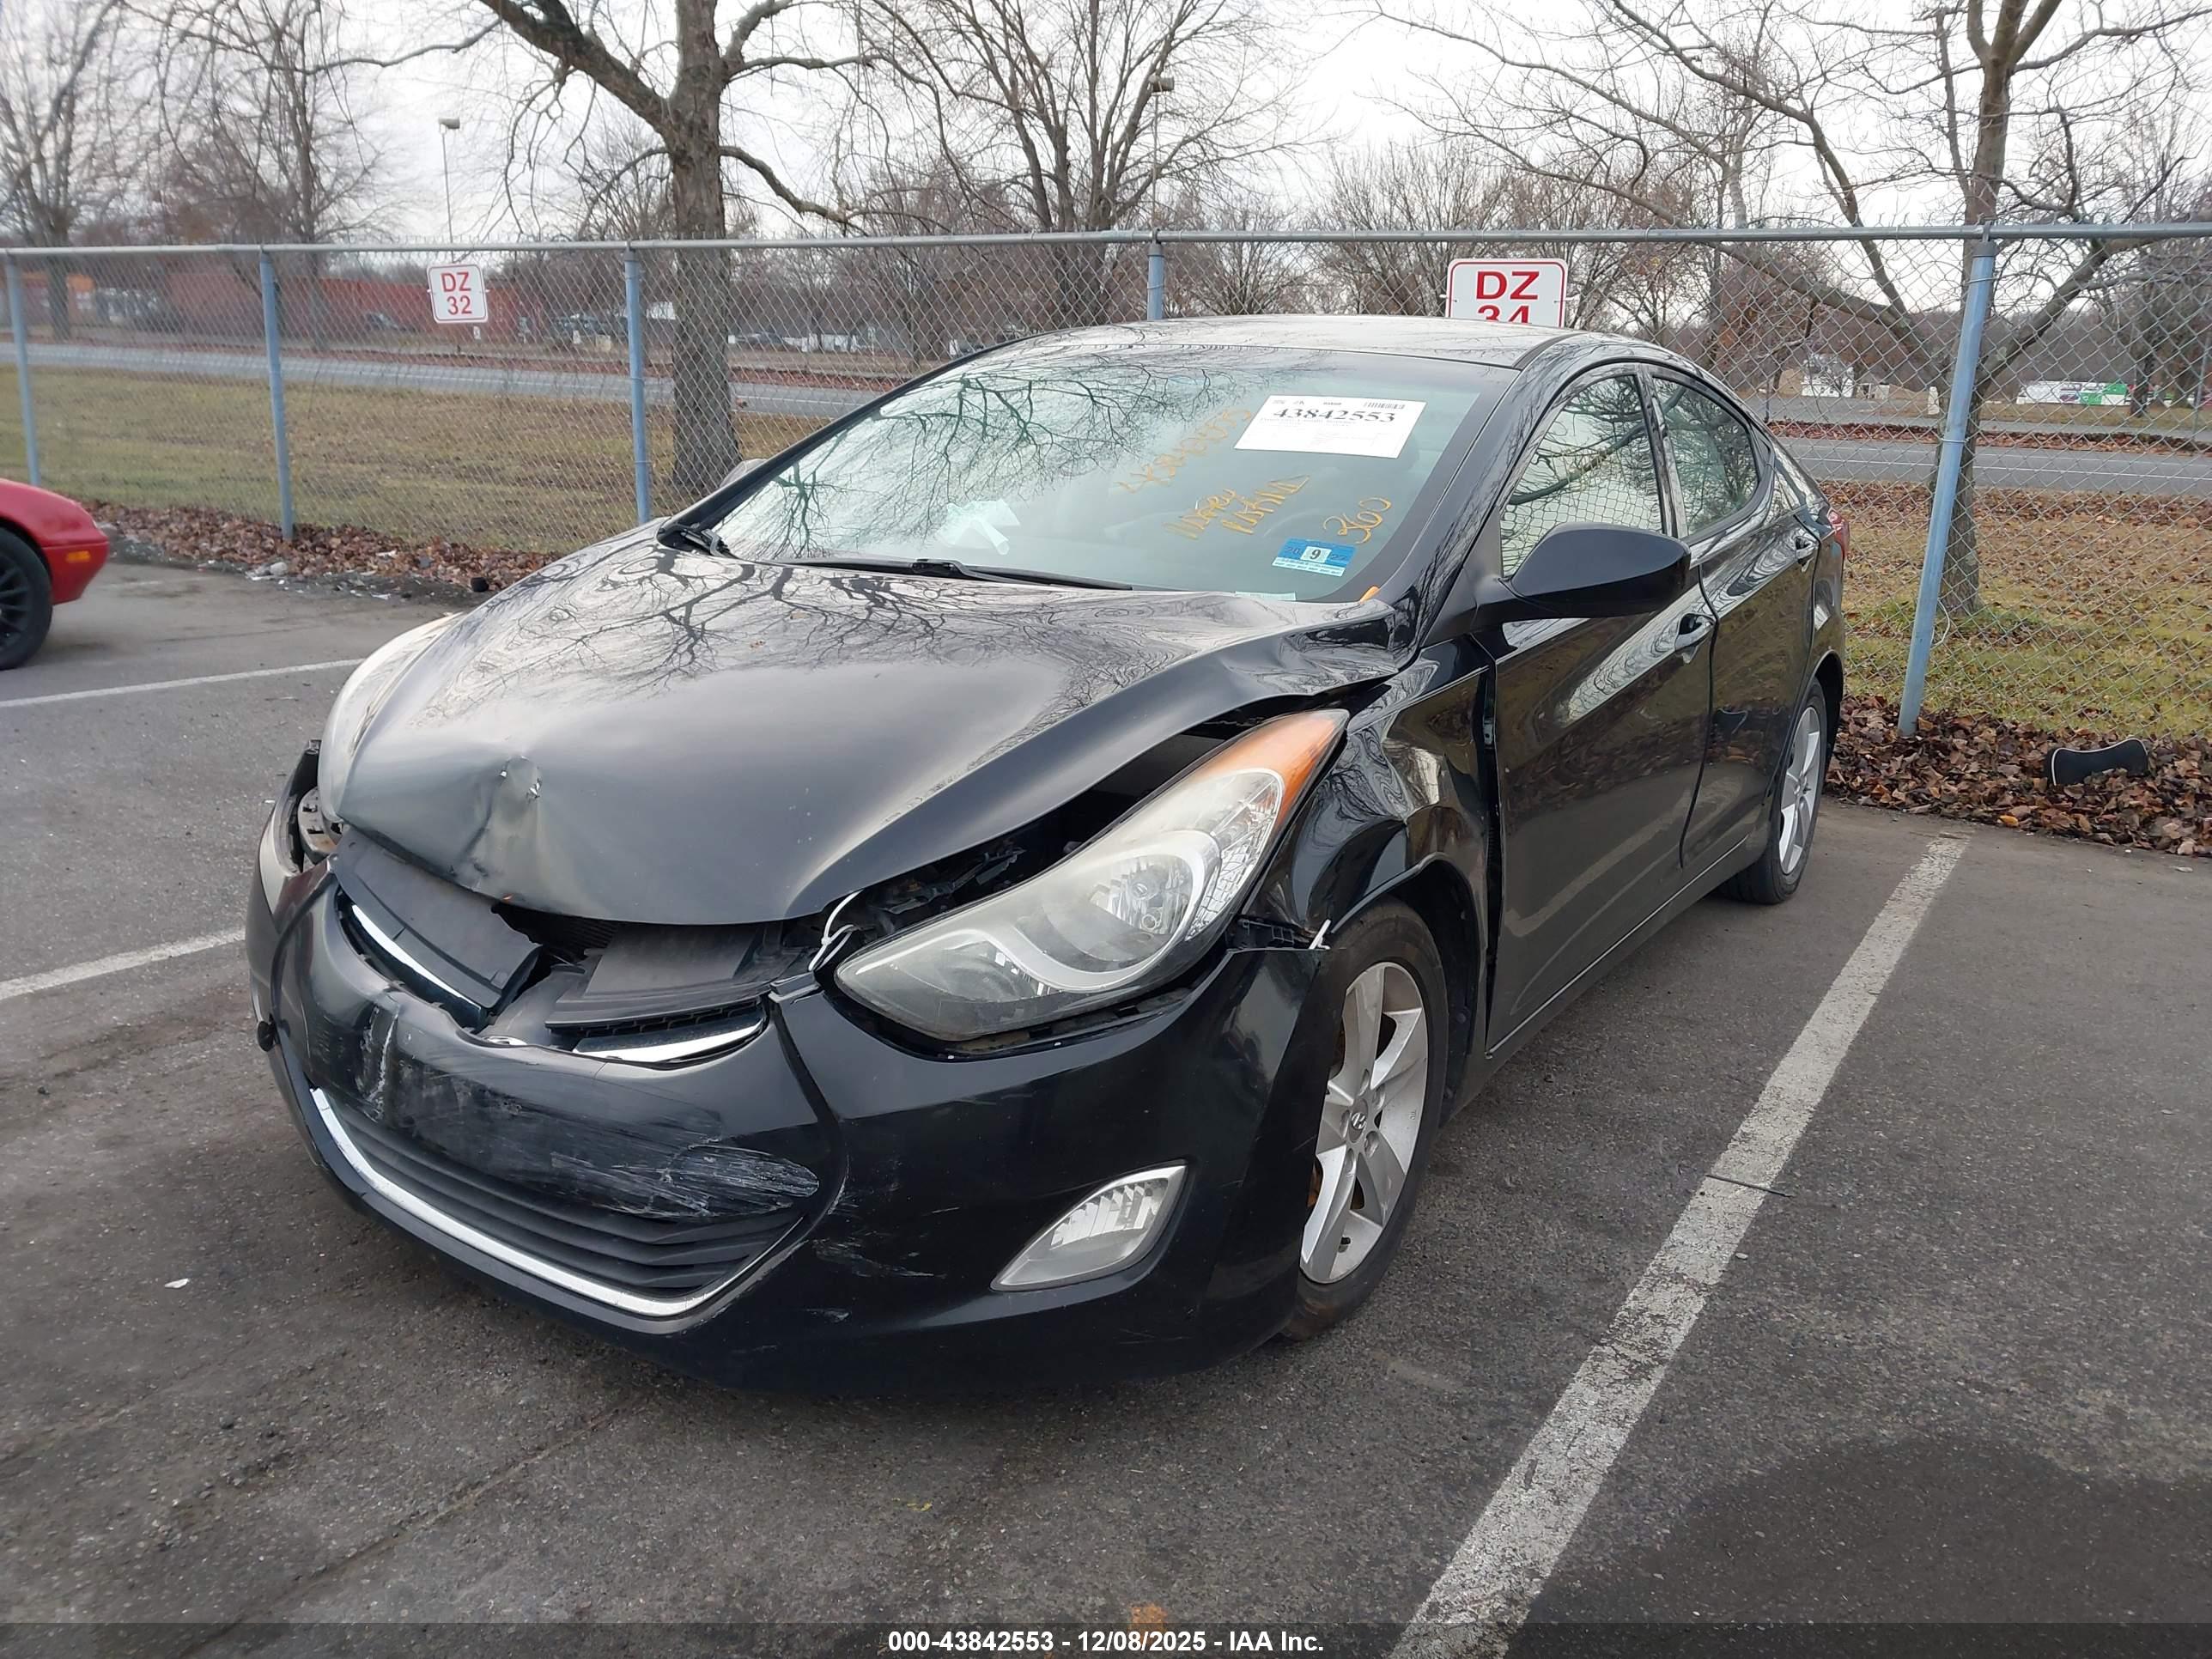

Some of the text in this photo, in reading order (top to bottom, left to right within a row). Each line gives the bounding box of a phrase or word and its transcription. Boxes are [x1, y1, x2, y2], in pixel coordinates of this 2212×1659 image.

[441, 271, 471, 293] DZ
[1476, 270, 1540, 301] DZ
[447, 295, 472, 315] 32
[1273, 408, 1395, 422] 43842553
[1323, 496, 1392, 544] 360
[1310, 549, 1322, 560] 9
